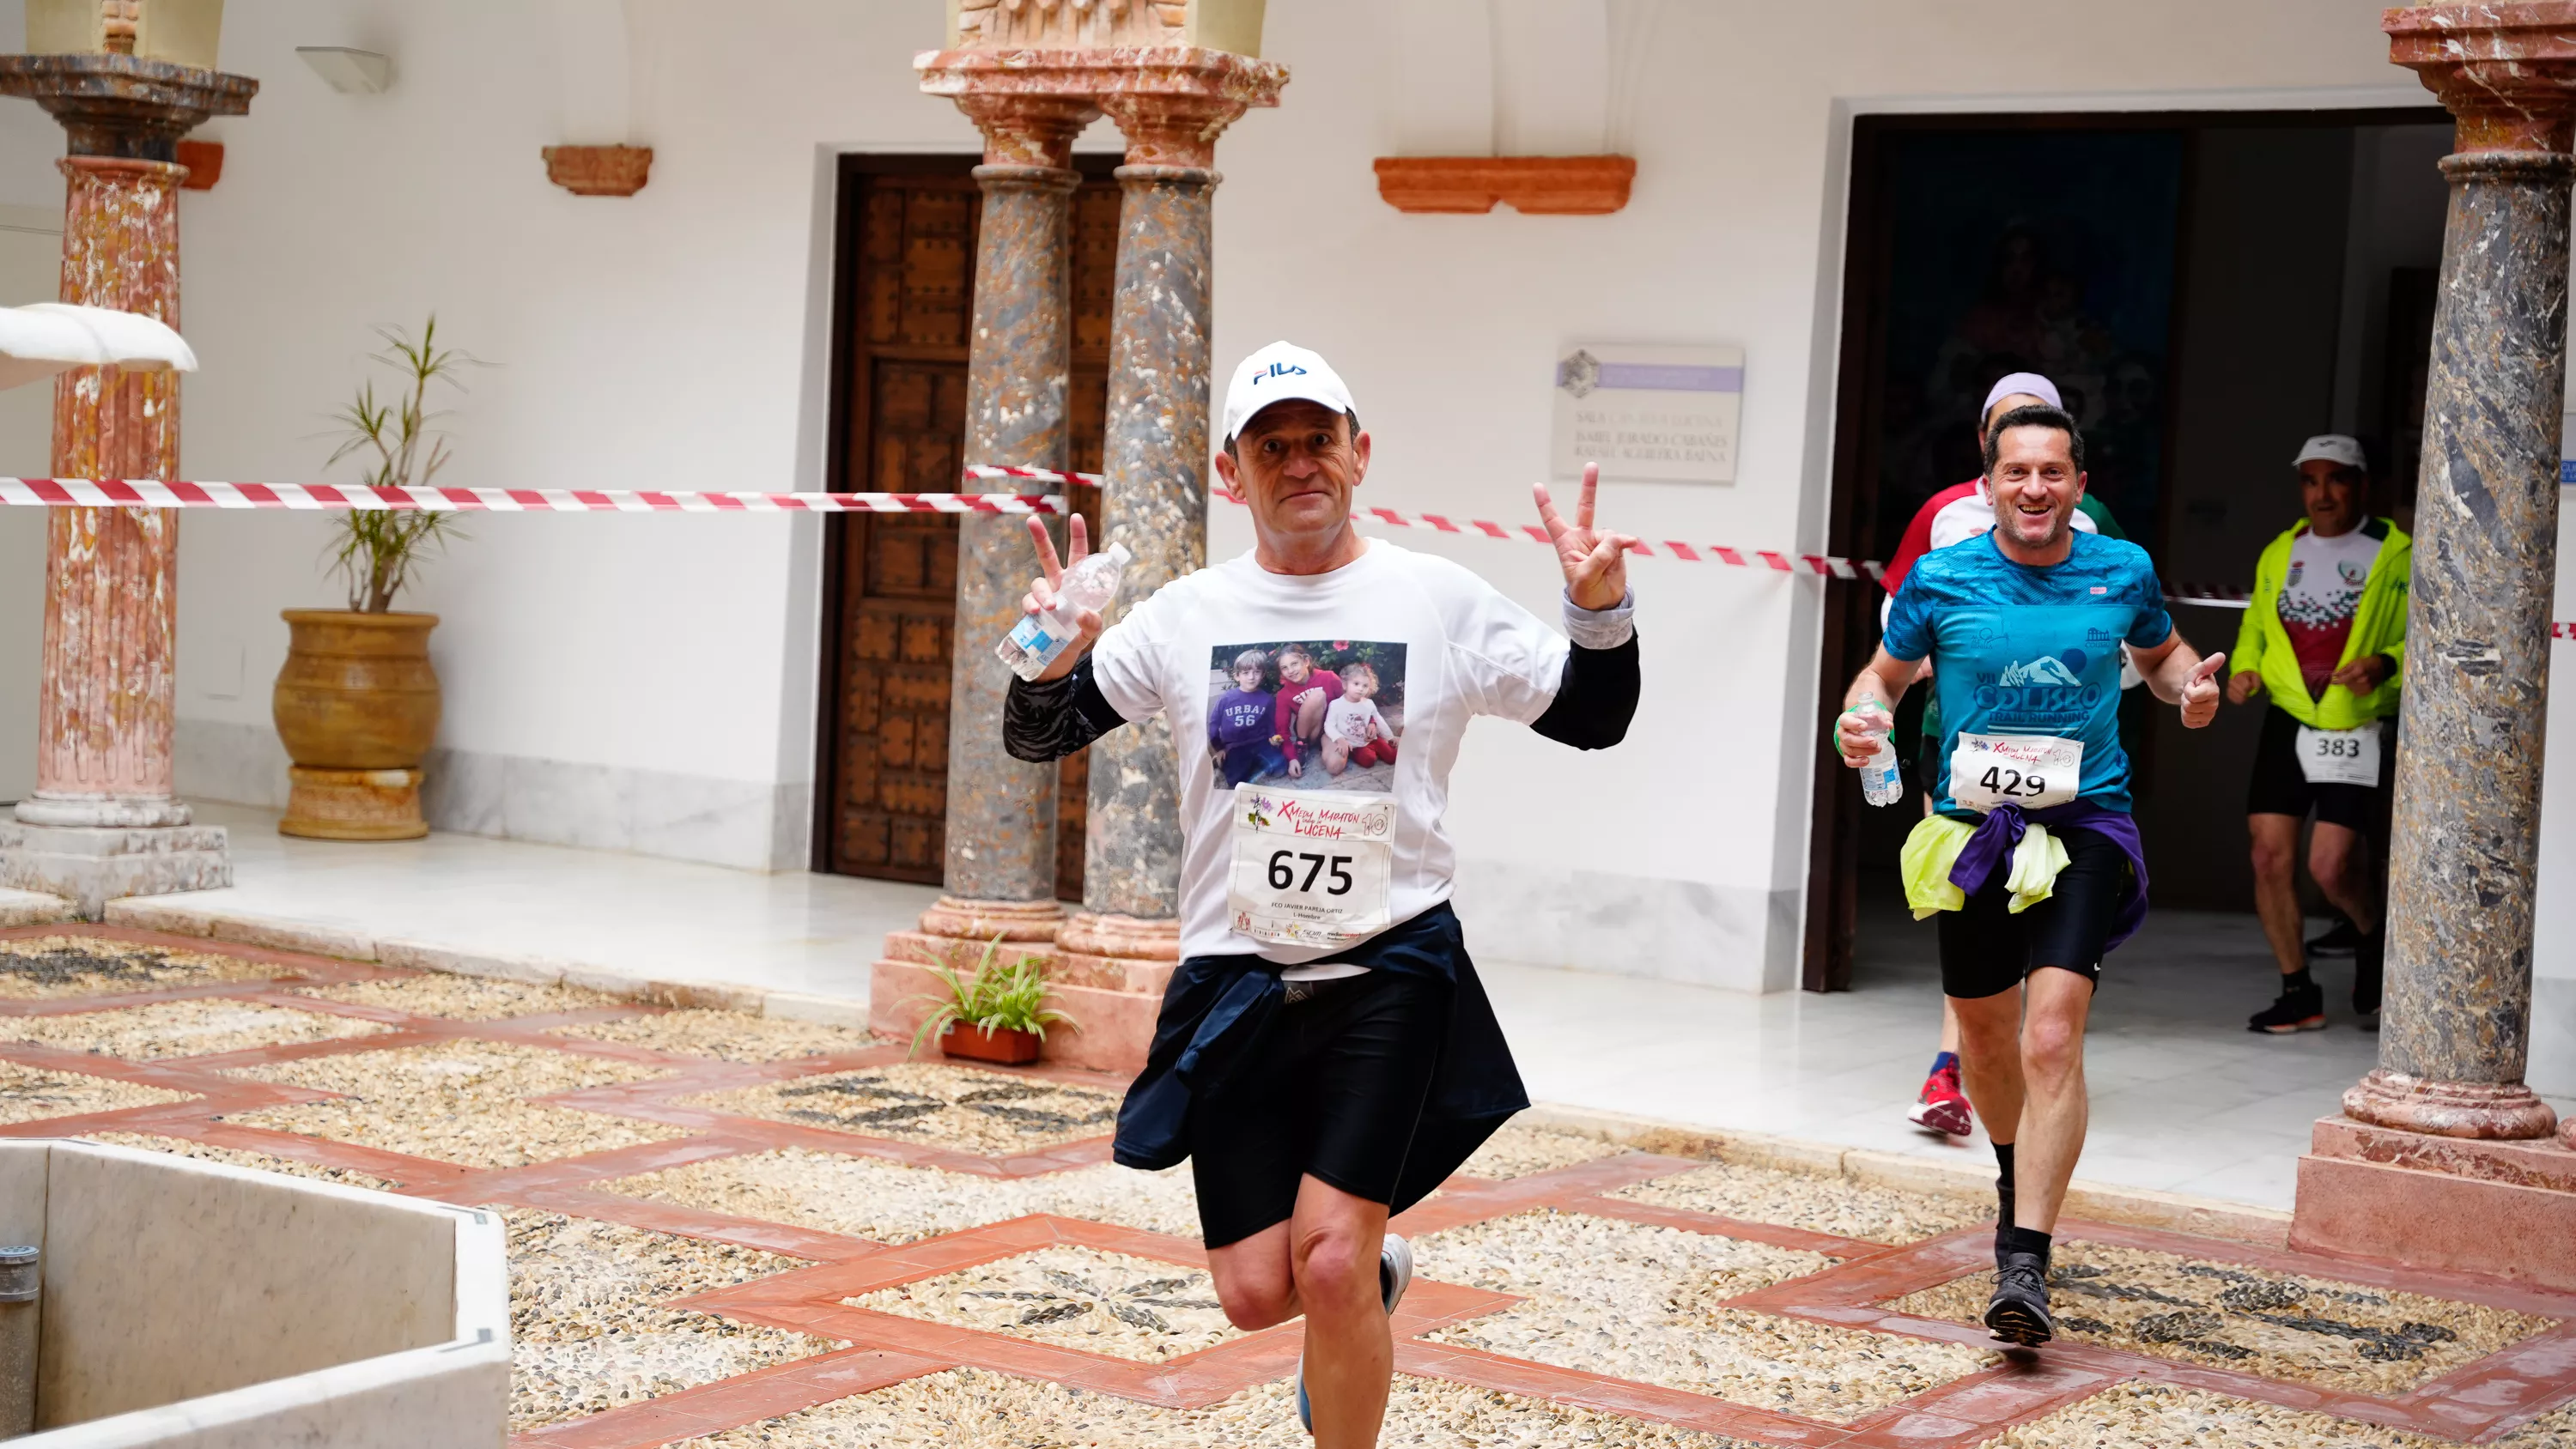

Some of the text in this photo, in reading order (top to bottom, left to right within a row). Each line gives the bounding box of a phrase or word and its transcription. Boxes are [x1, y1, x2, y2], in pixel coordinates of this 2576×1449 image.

[1253, 362, 1308, 385] FILA
[1976, 672, 1996, 685] VII
[1973, 682, 2102, 712] COLISEO
[1234, 714, 1256, 728] 56
[1988, 710, 2091, 723] TRAIL RUNNING
[2316, 737, 2360, 758] 383
[1979, 766, 2045, 797] 429
[1277, 800, 1296, 822] X
[1294, 819, 1346, 840] LUCENA
[1267, 850, 1353, 895] 675
[1293, 912, 1321, 920] L-Hombre
